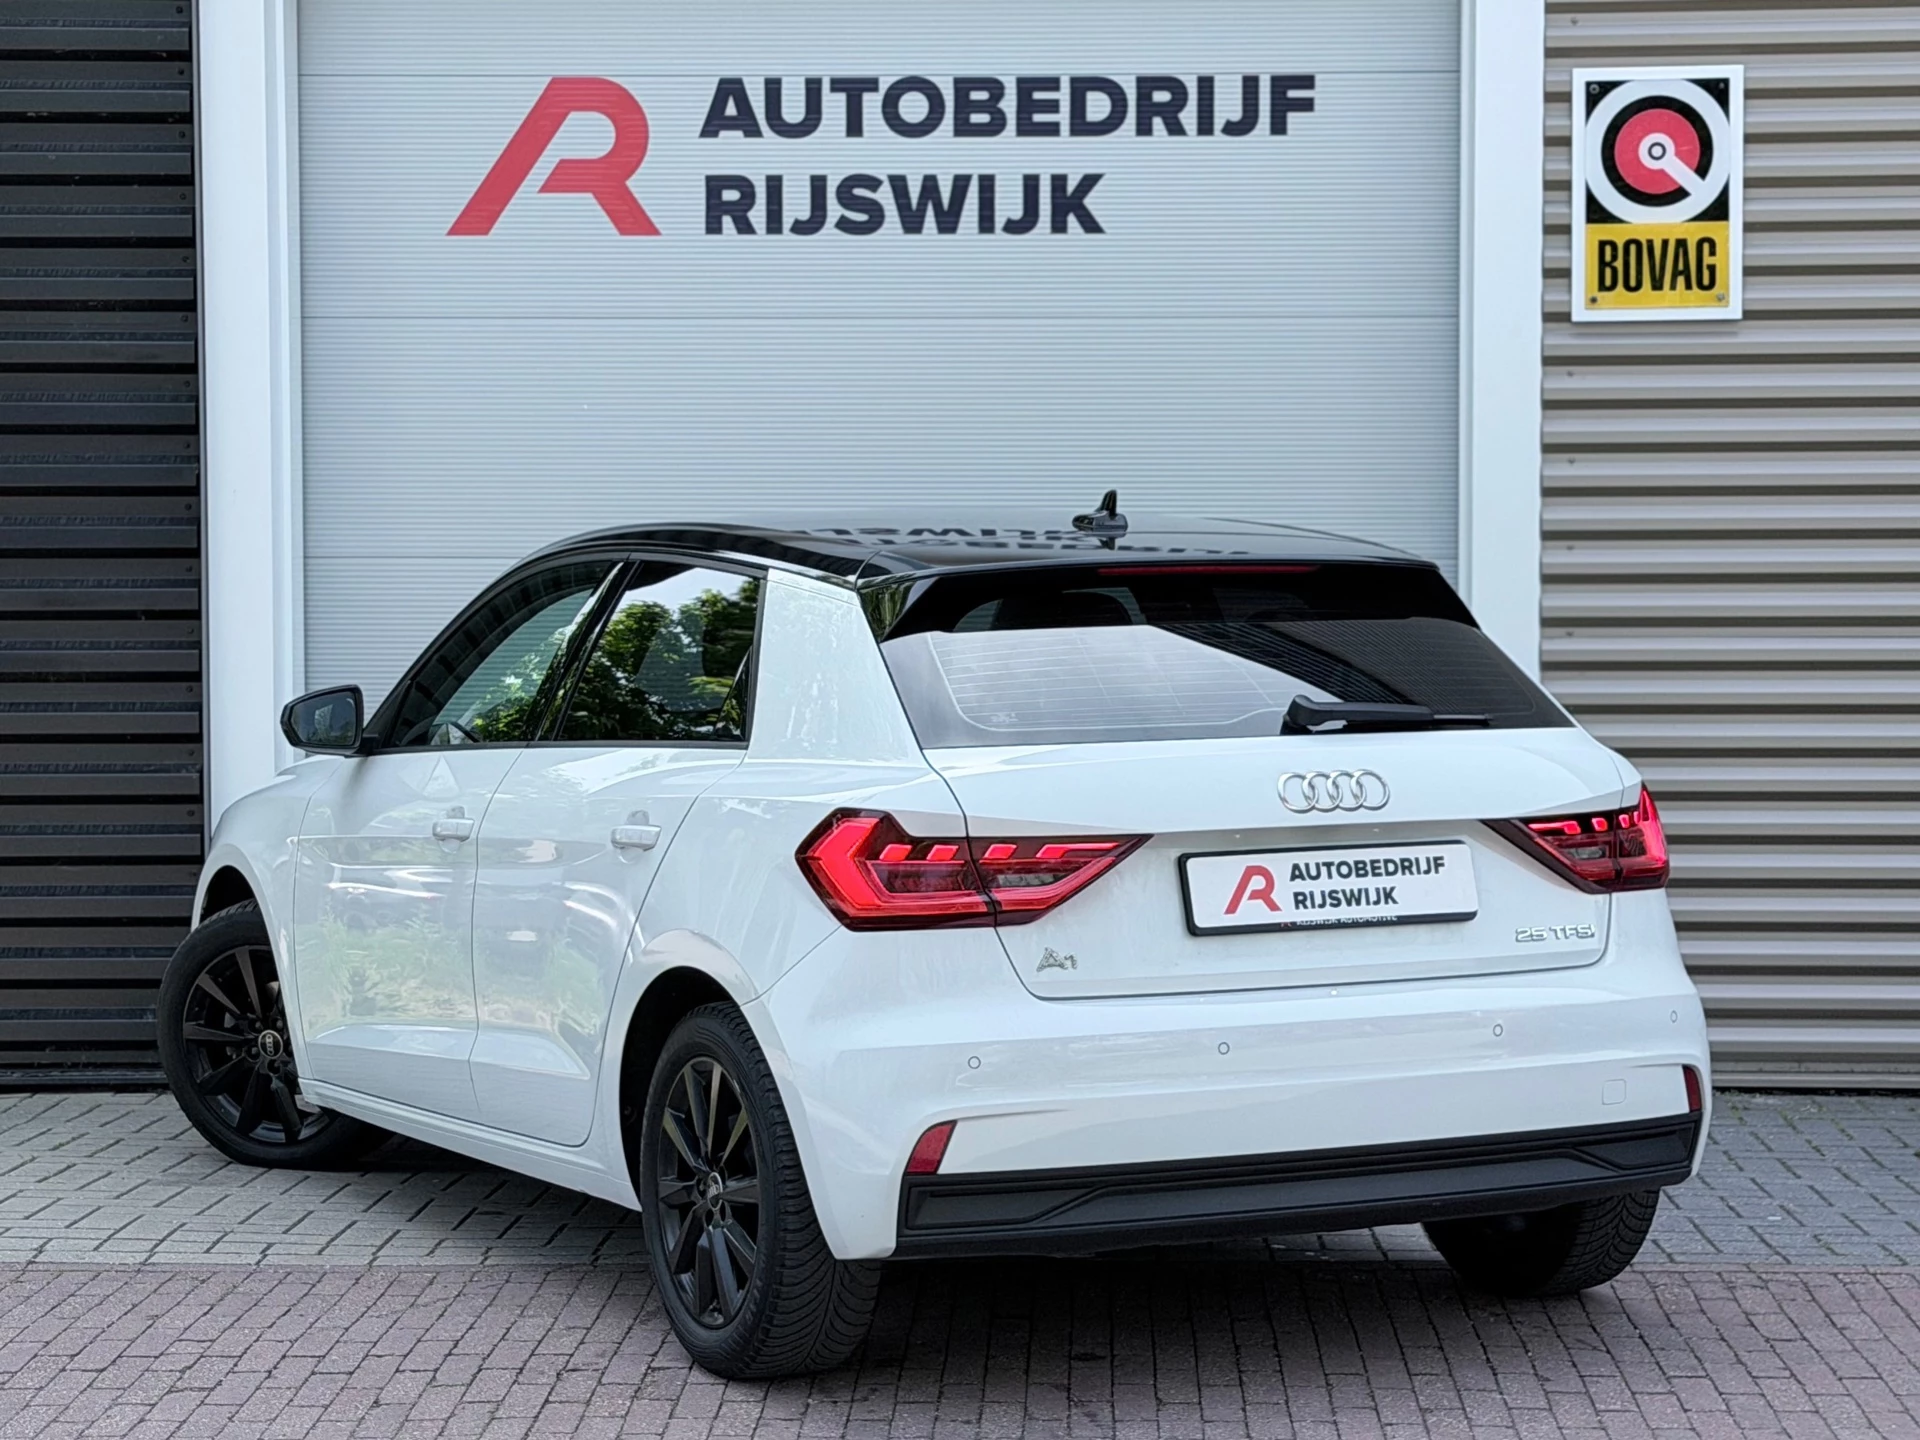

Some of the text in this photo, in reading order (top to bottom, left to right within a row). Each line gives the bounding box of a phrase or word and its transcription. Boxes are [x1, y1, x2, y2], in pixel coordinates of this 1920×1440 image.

[698, 73, 1316, 139] AUTOBEDRIJF
[704, 172, 1107, 236] RIJSWIJK
[1597, 235, 1718, 294] BOVAG
[1289, 856, 1446, 882] AUTOBEDRIJF
[1292, 886, 1400, 911] RIJSWIJK
[1515, 923, 1596, 943] 25 TFSI
[1036, 946, 1078, 973] A1
